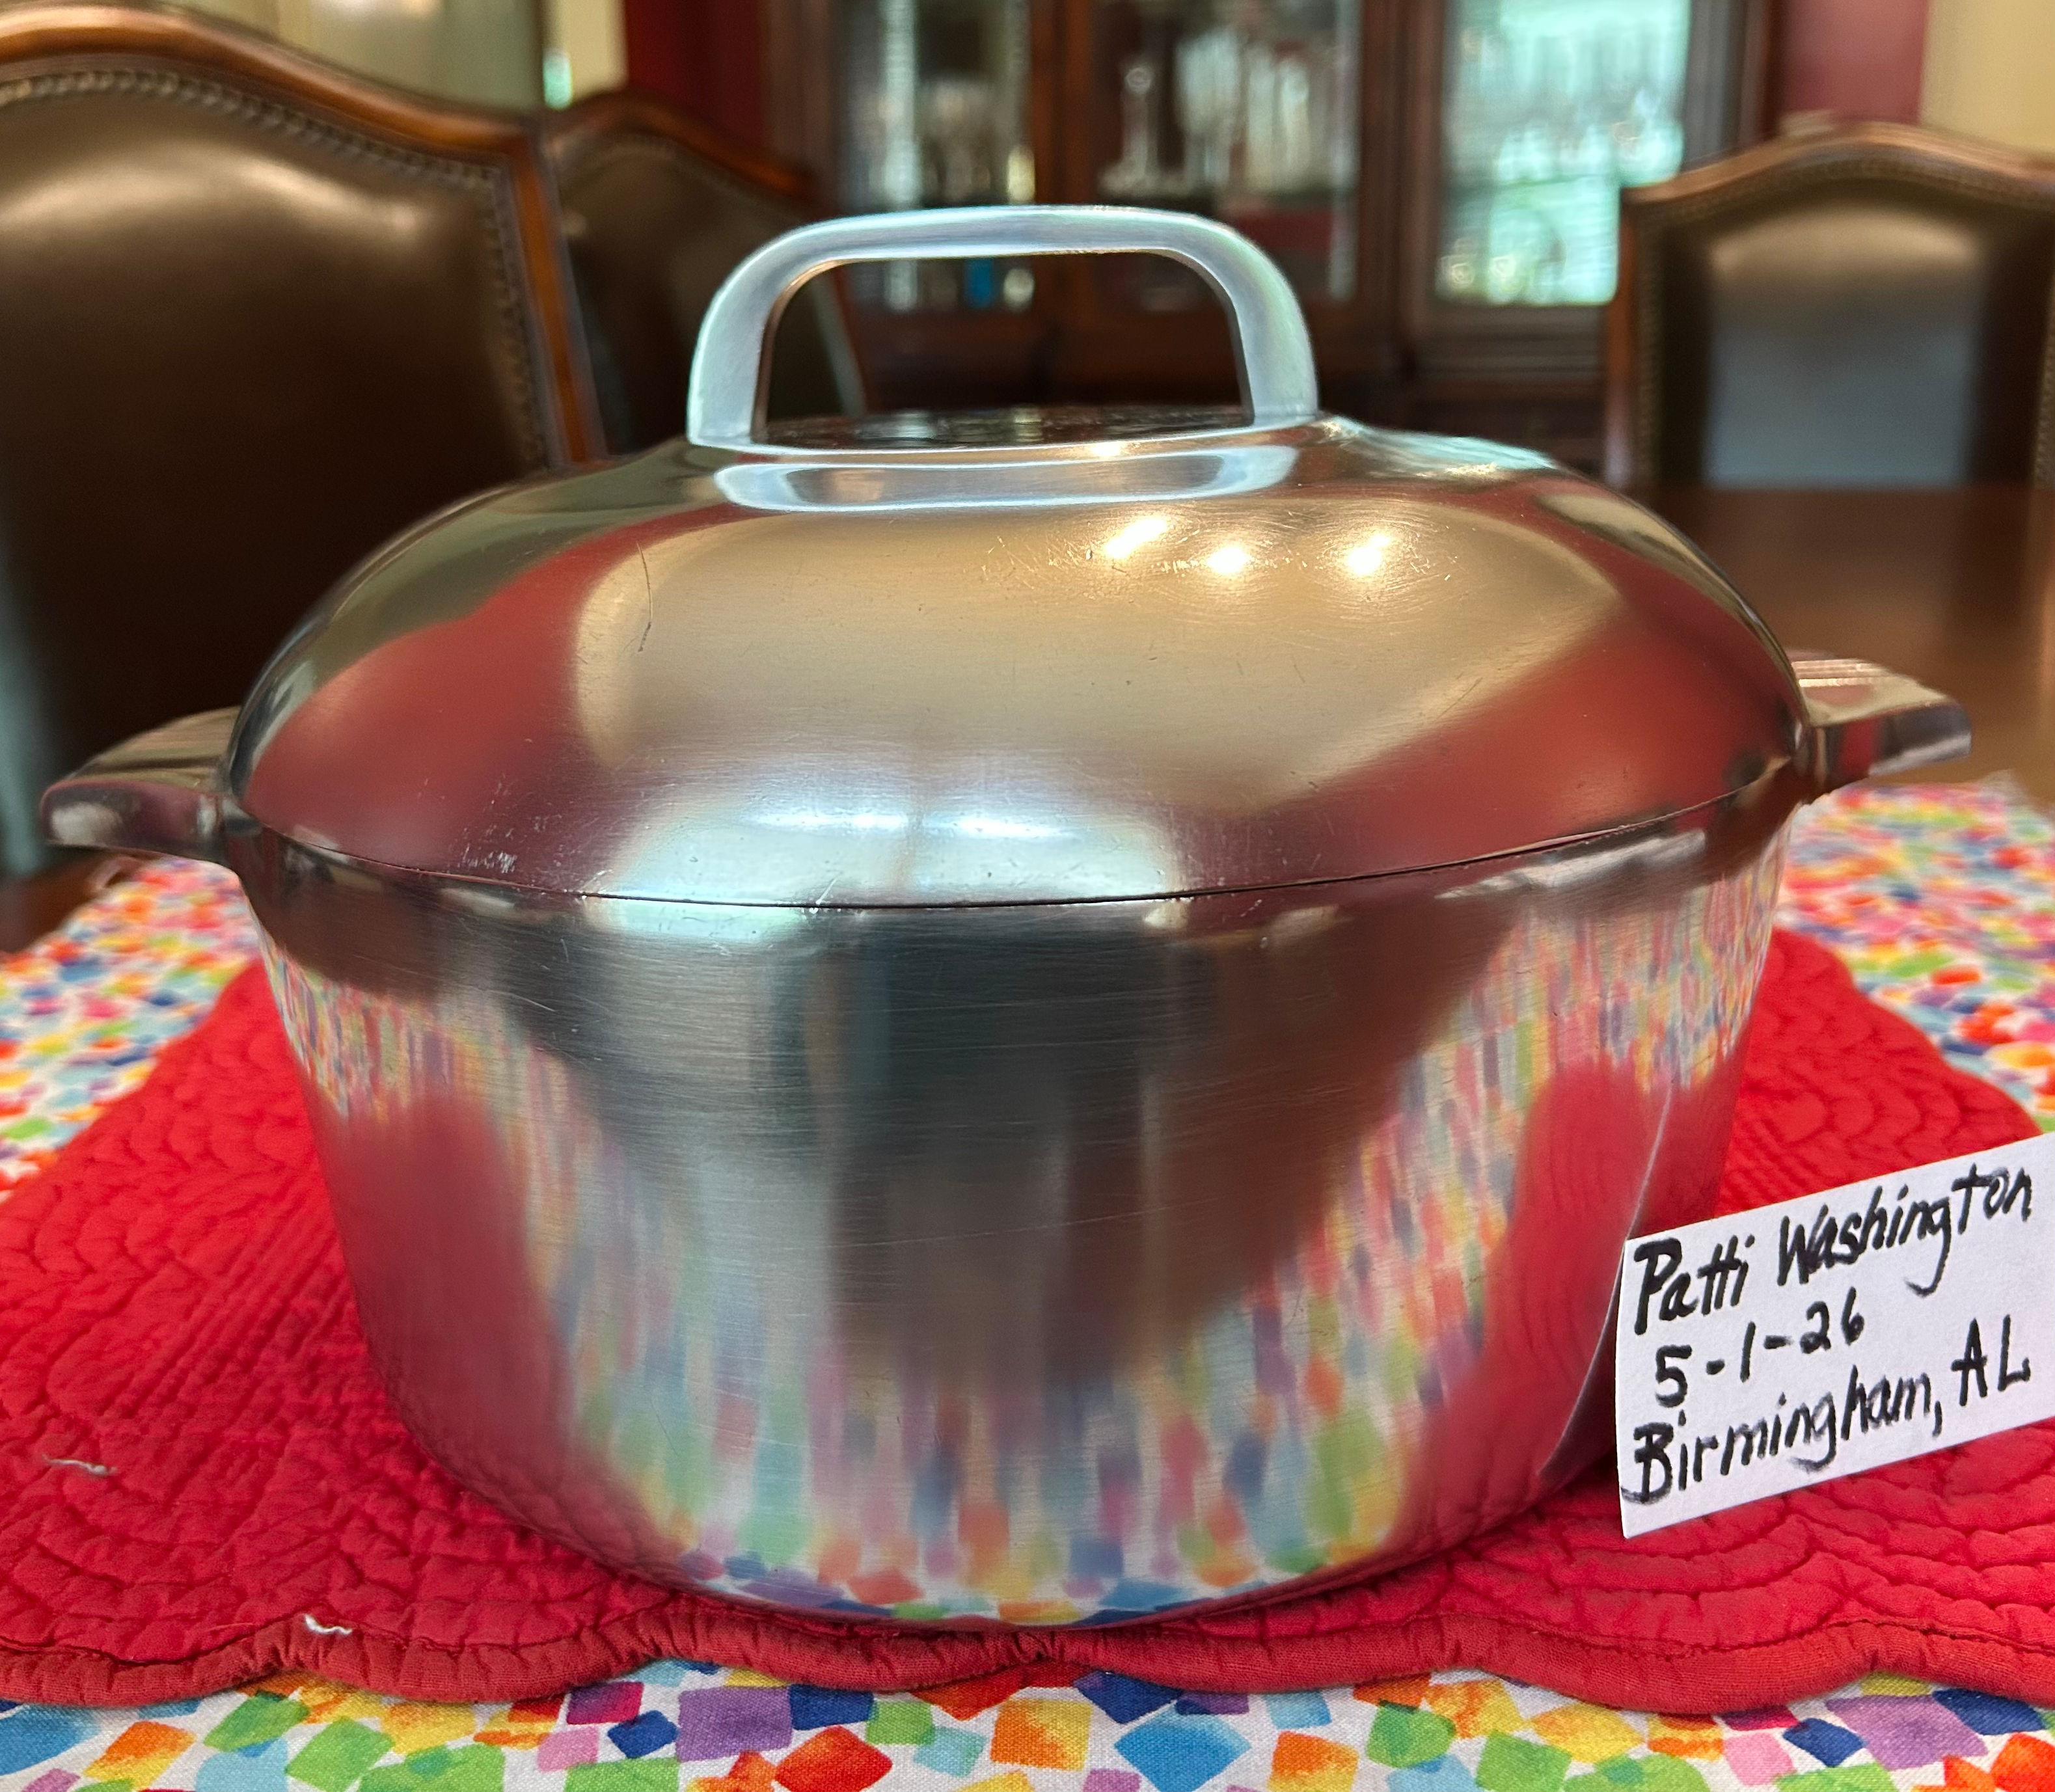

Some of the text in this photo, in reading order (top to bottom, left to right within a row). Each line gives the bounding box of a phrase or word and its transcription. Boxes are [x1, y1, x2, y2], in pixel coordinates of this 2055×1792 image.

[1634, 1163, 2032, 1335] Patti Washington
[1620, 1314, 2031, 1504] Birmingham, AL
[1655, 1286, 1865, 1408] 5-1-26
